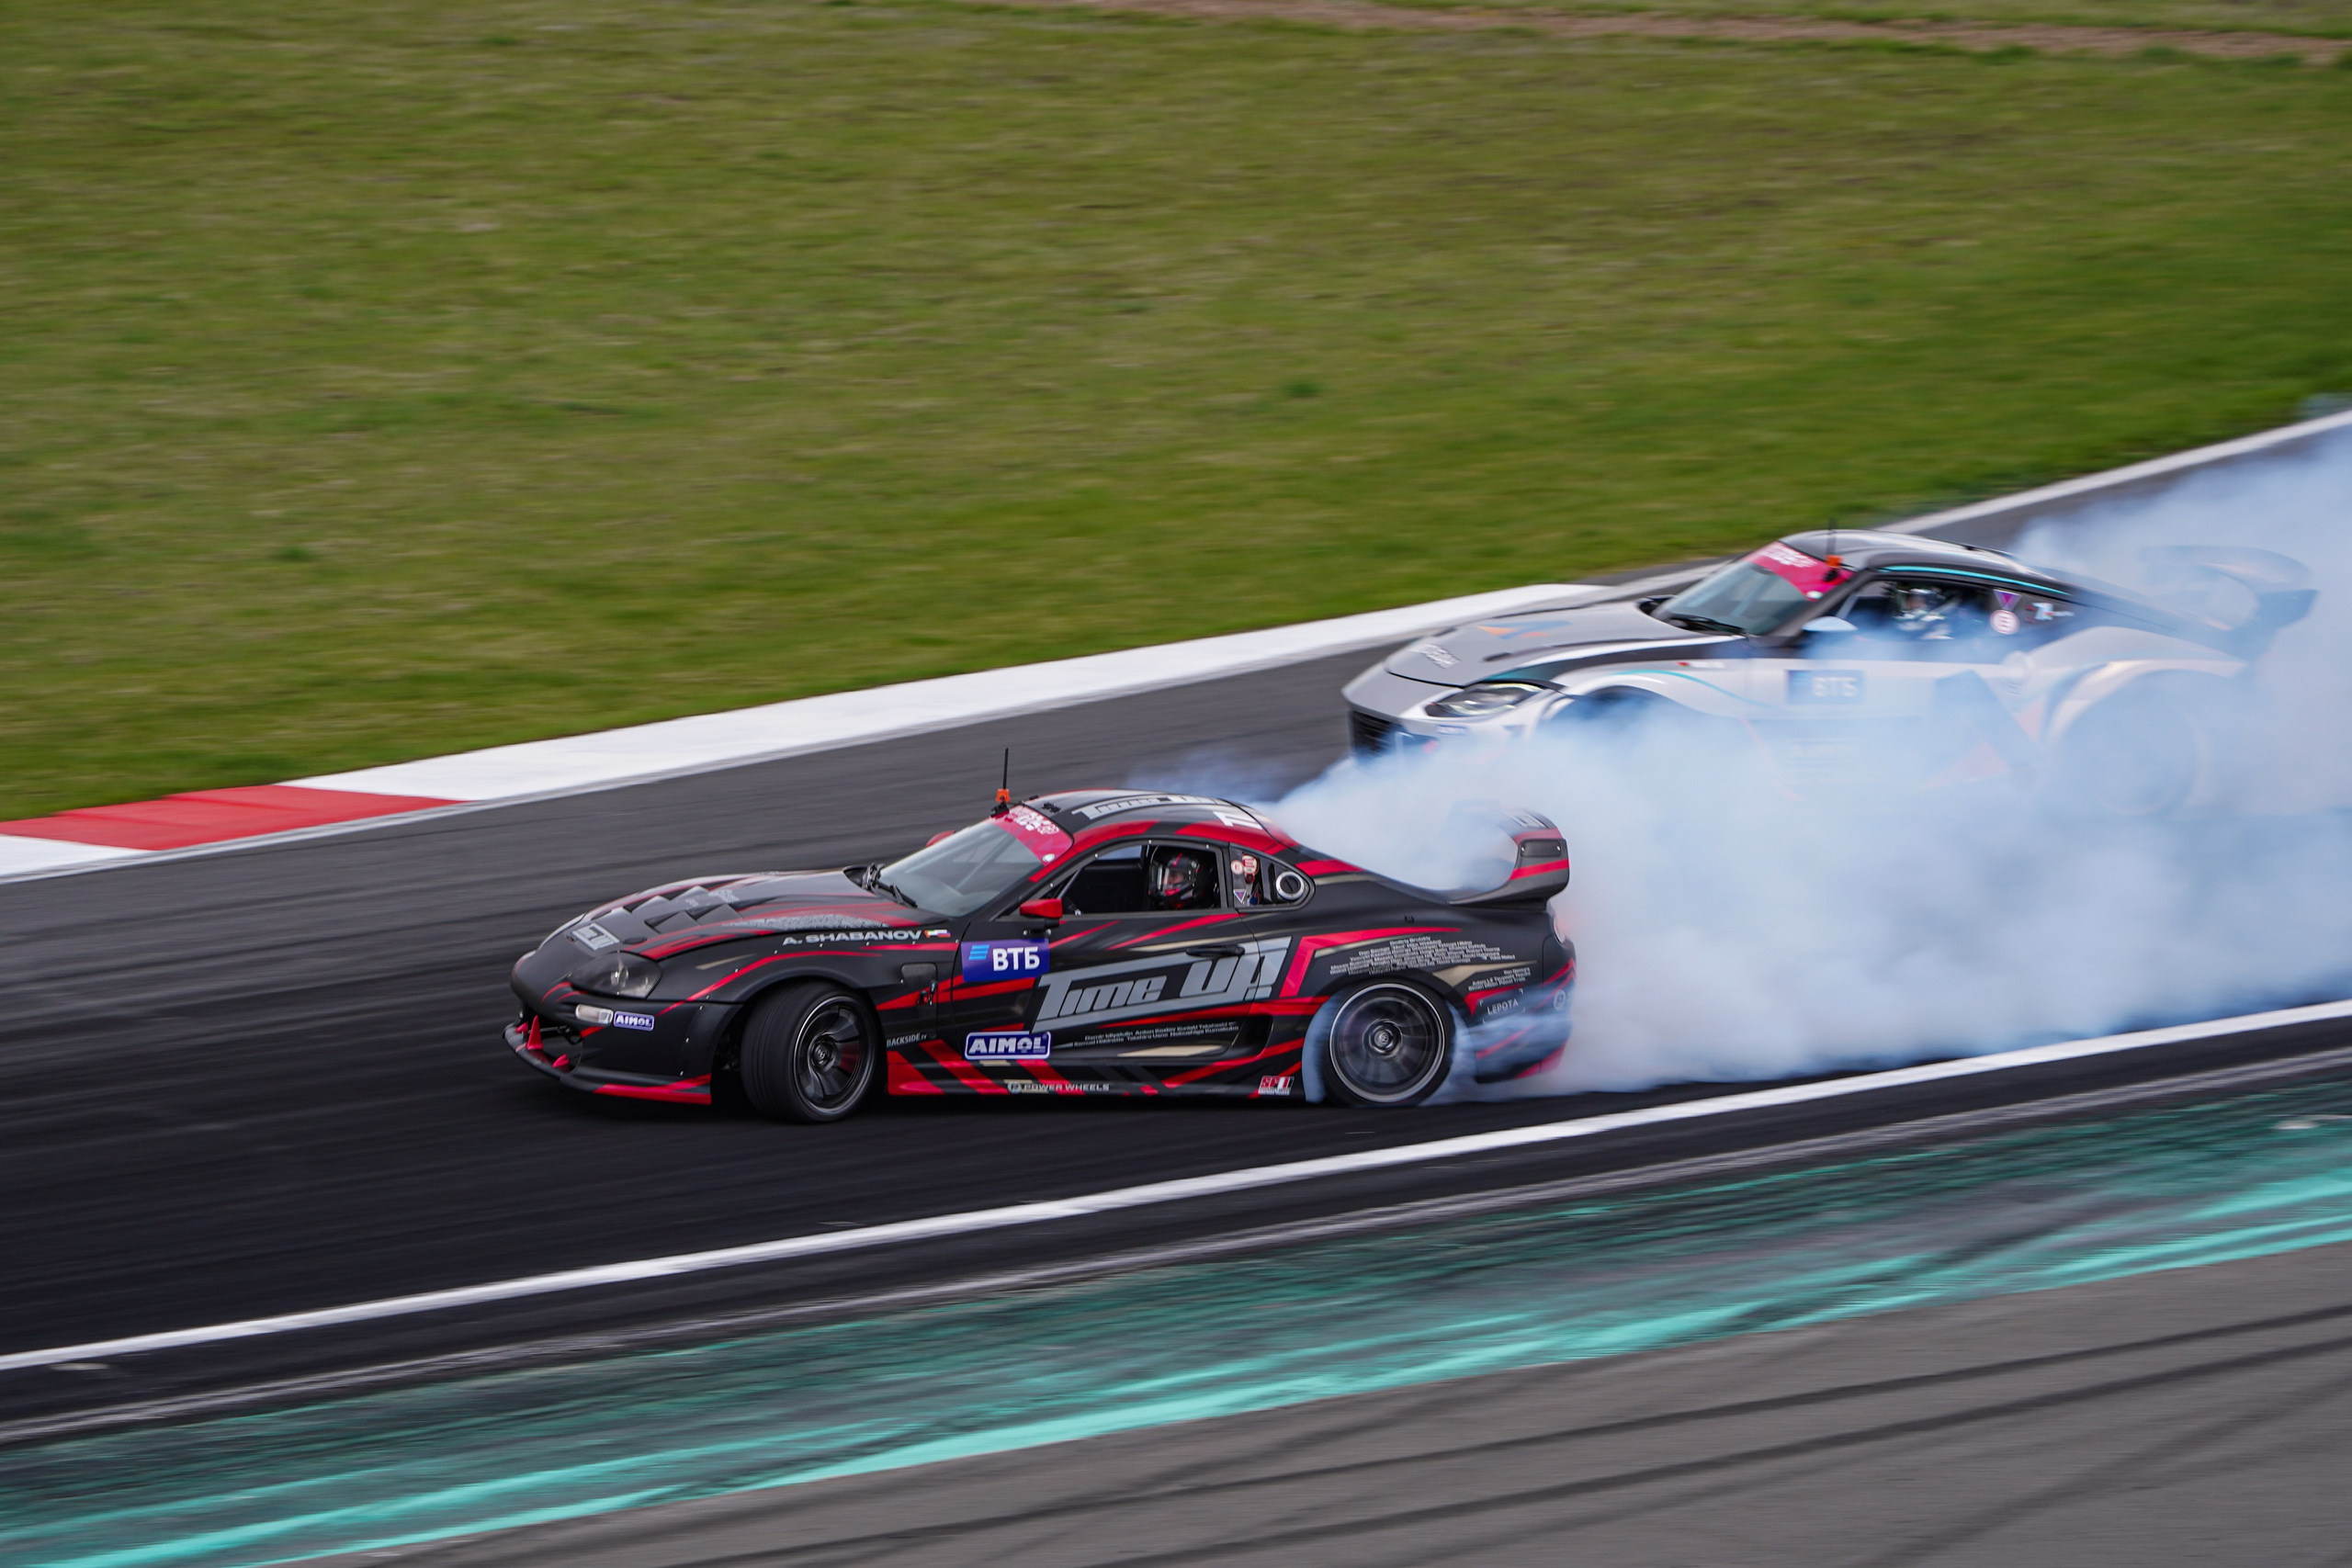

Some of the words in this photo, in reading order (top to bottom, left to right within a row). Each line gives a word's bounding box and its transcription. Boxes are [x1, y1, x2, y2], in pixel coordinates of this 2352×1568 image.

[783, 937, 803, 946] A.
[806, 930, 922, 943] SHABANOV
[992, 945, 1040, 972] ВТБ
[1487, 998, 1519, 1016] LEPOTA
[615, 1014, 652, 1028] AIMOL
[886, 1033, 921, 1048] BACKSIDE
[968, 1036, 1046, 1055] AIMOL
[1023, 1083, 1064, 1092] POWER
[1066, 1083, 1110, 1092] WHEELS
